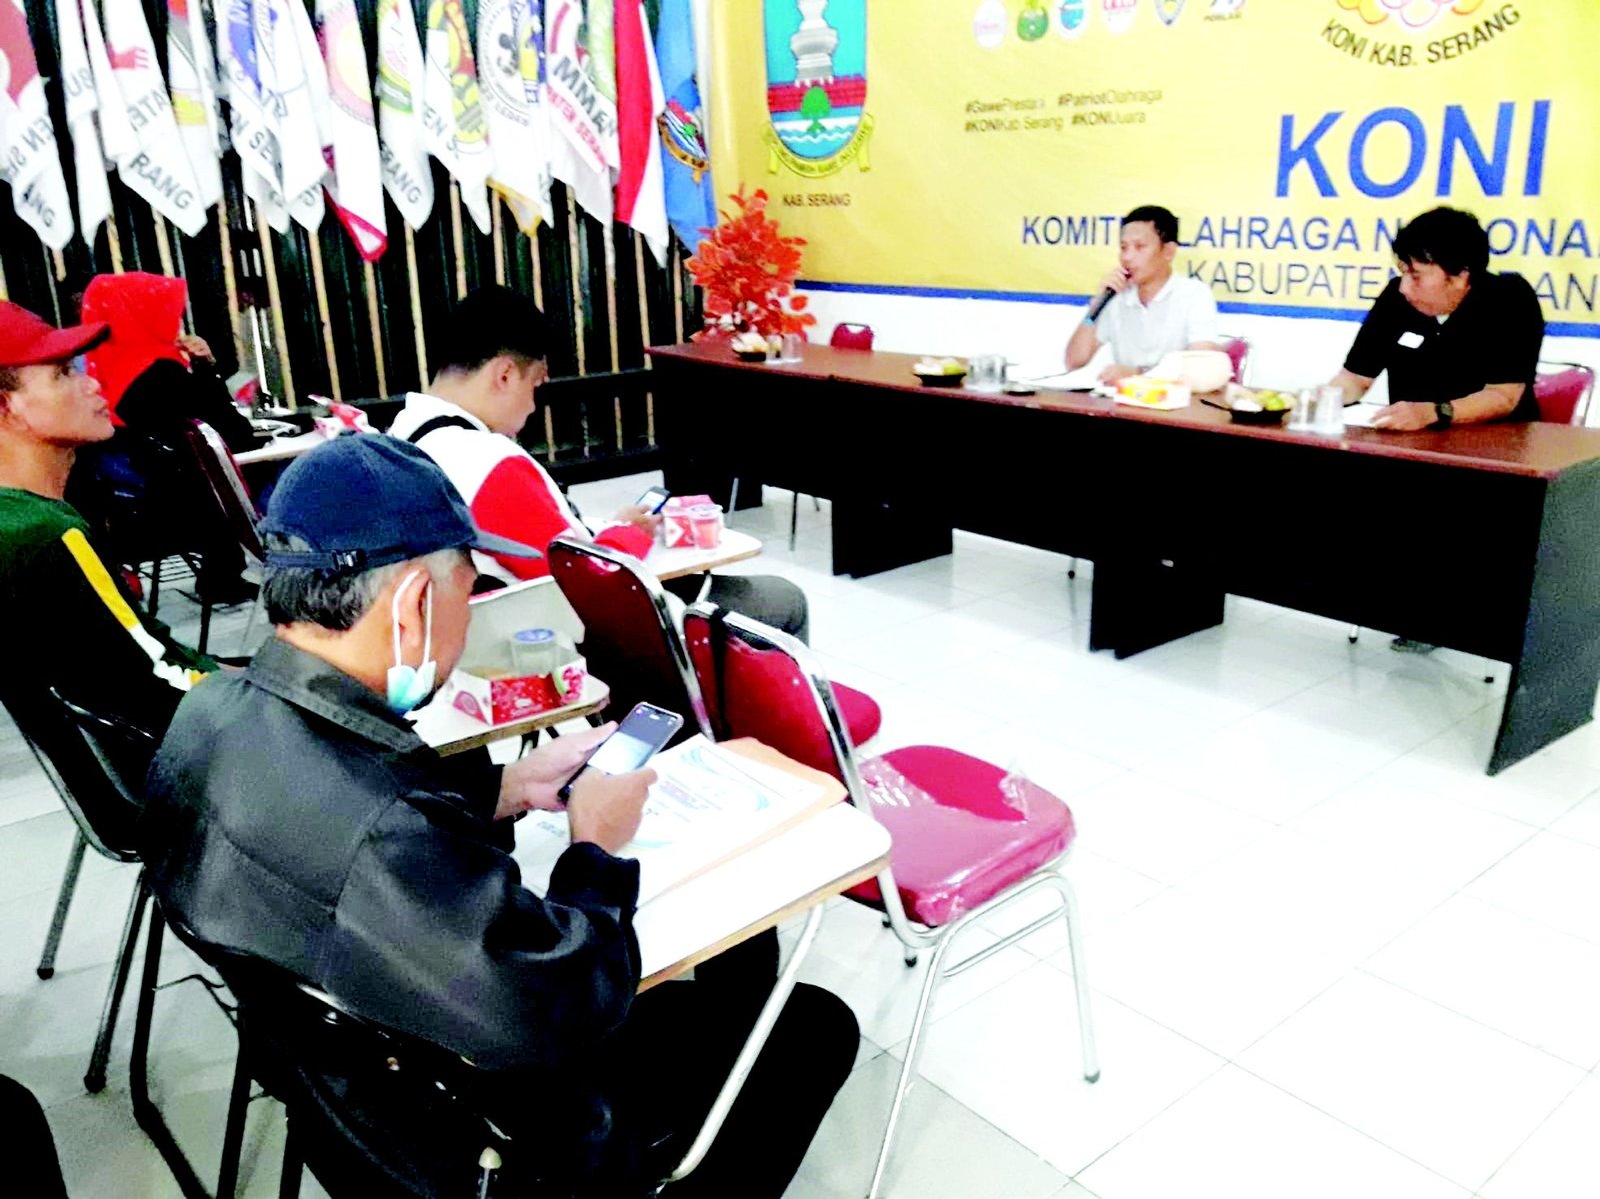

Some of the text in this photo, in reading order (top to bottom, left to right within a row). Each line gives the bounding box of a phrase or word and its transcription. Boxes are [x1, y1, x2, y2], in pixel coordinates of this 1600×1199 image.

[1321, 3, 1521, 67] KONI KAB. SERANG
[1275, 99, 1552, 199] KONI
[807, 193, 851, 207] SERANG
[1022, 215, 1126, 246] KOMIT
[1176, 216, 1360, 252] LAHRAGA
[1187, 259, 1400, 301] KABUPATE
